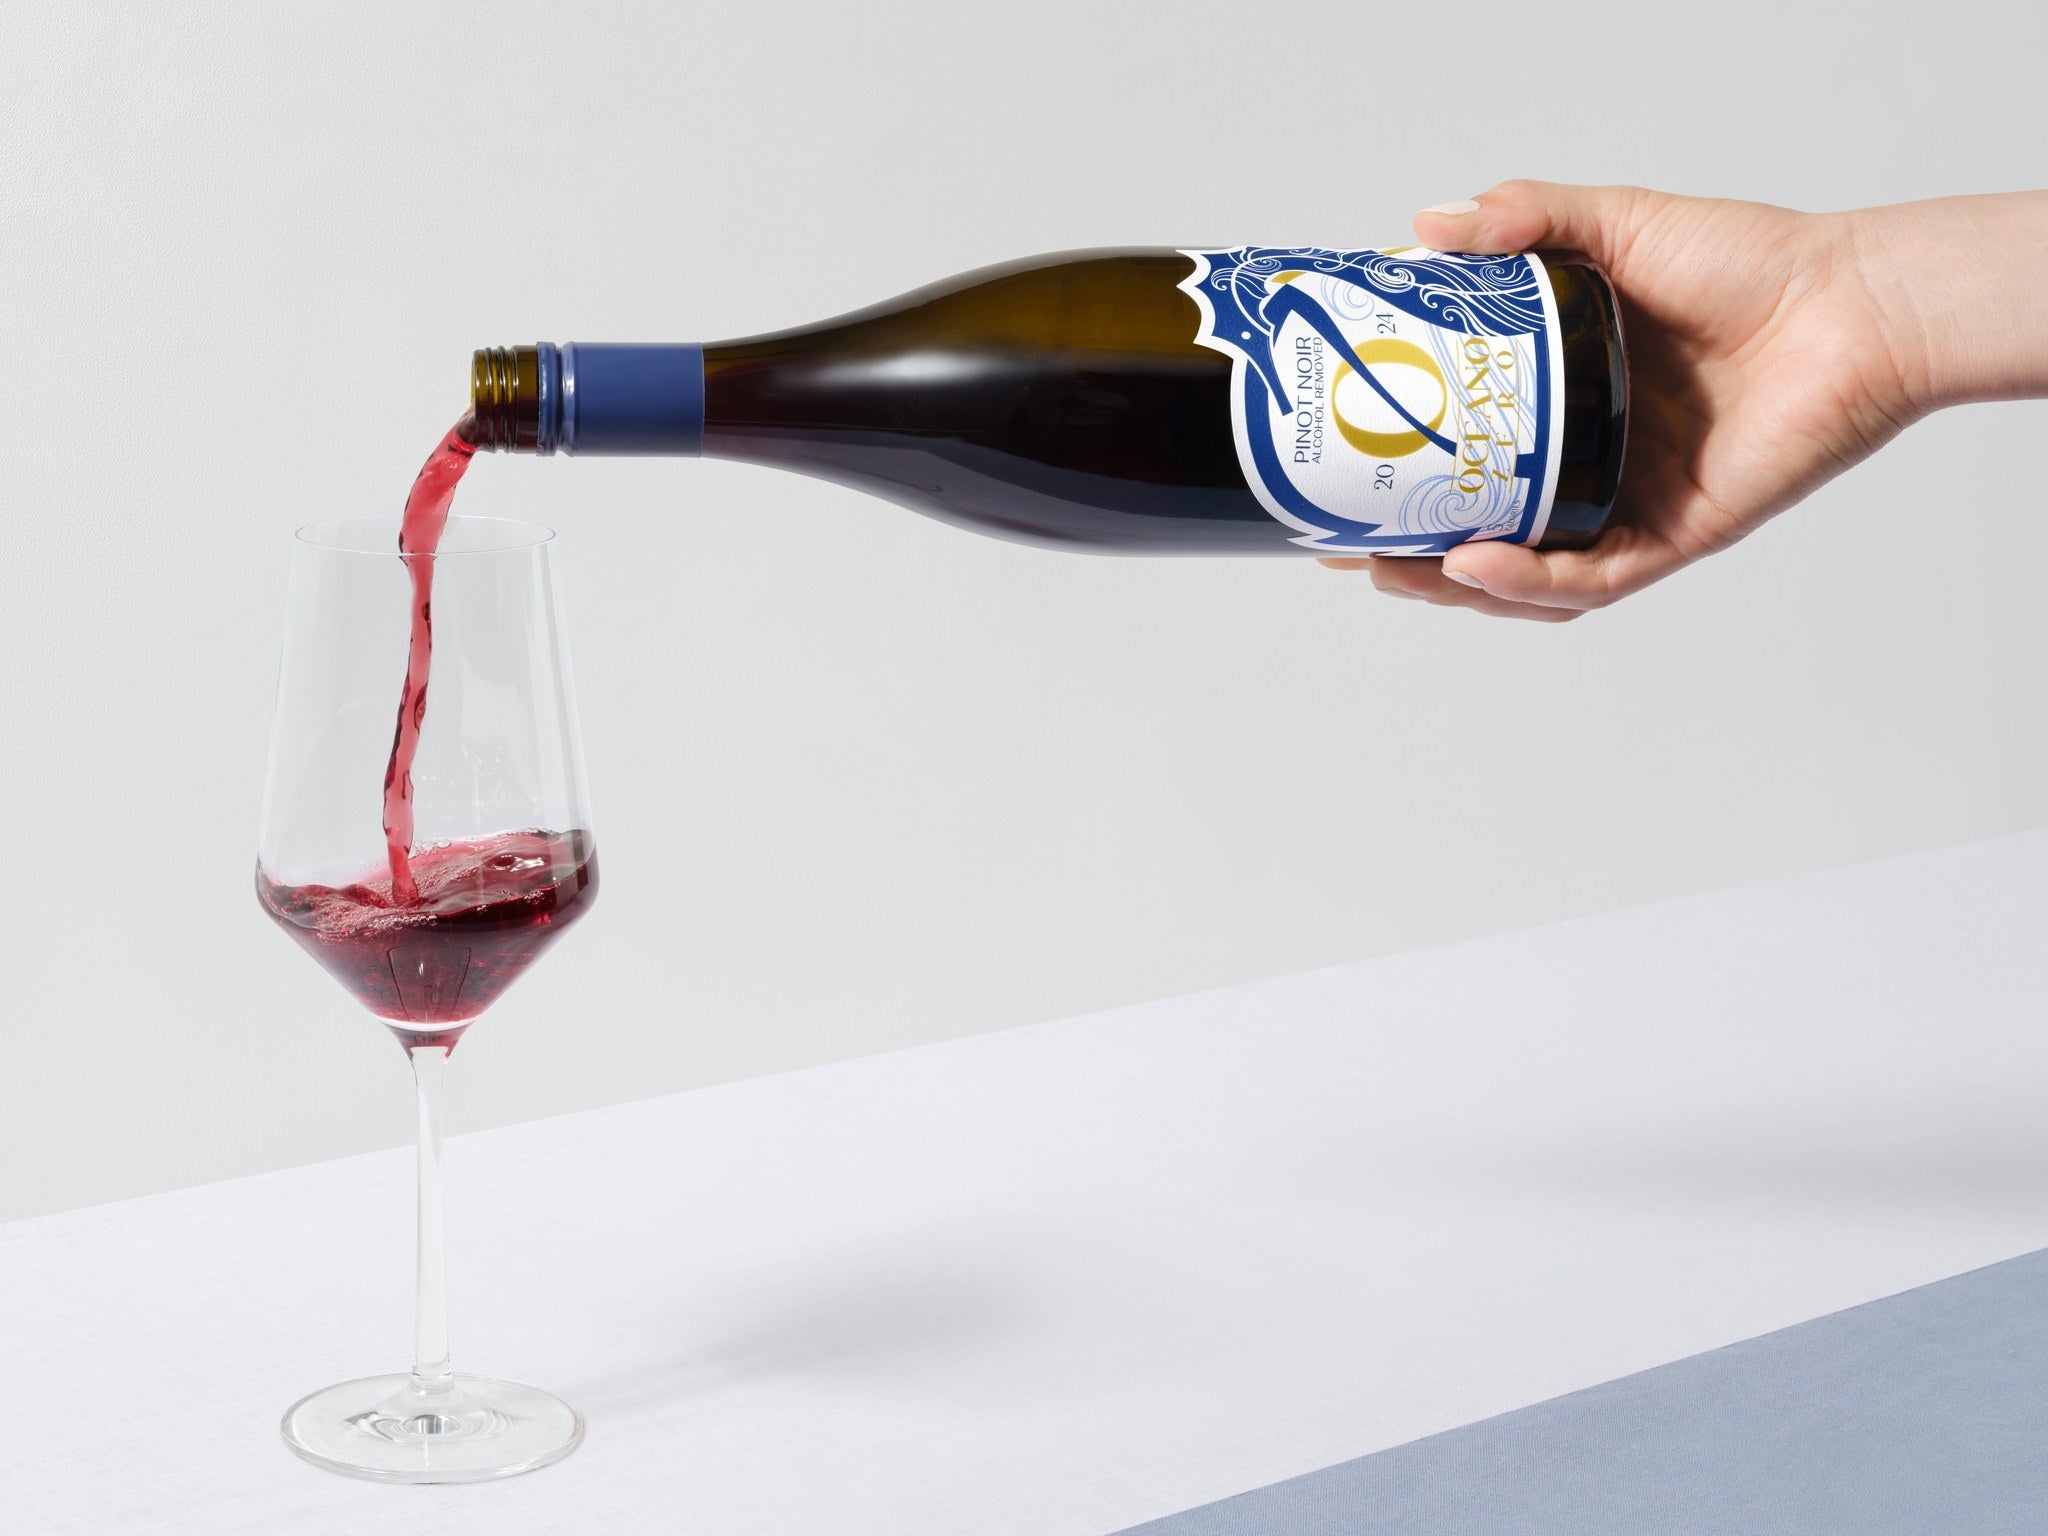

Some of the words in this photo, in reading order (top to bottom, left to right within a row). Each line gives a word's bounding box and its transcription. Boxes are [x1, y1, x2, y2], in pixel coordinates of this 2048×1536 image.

[1377, 312, 1397, 335] 24
[1294, 336, 1313, 391] NOIR
[1314, 336, 1324, 398] REMOVED
[1294, 395, 1314, 465] PINOT
[1312, 402, 1325, 465] ALCOHOL
[1491, 350, 1516, 484] ZERO
[1373, 463, 1395, 491] 20
[1505, 499, 1522, 533] CALORIES
